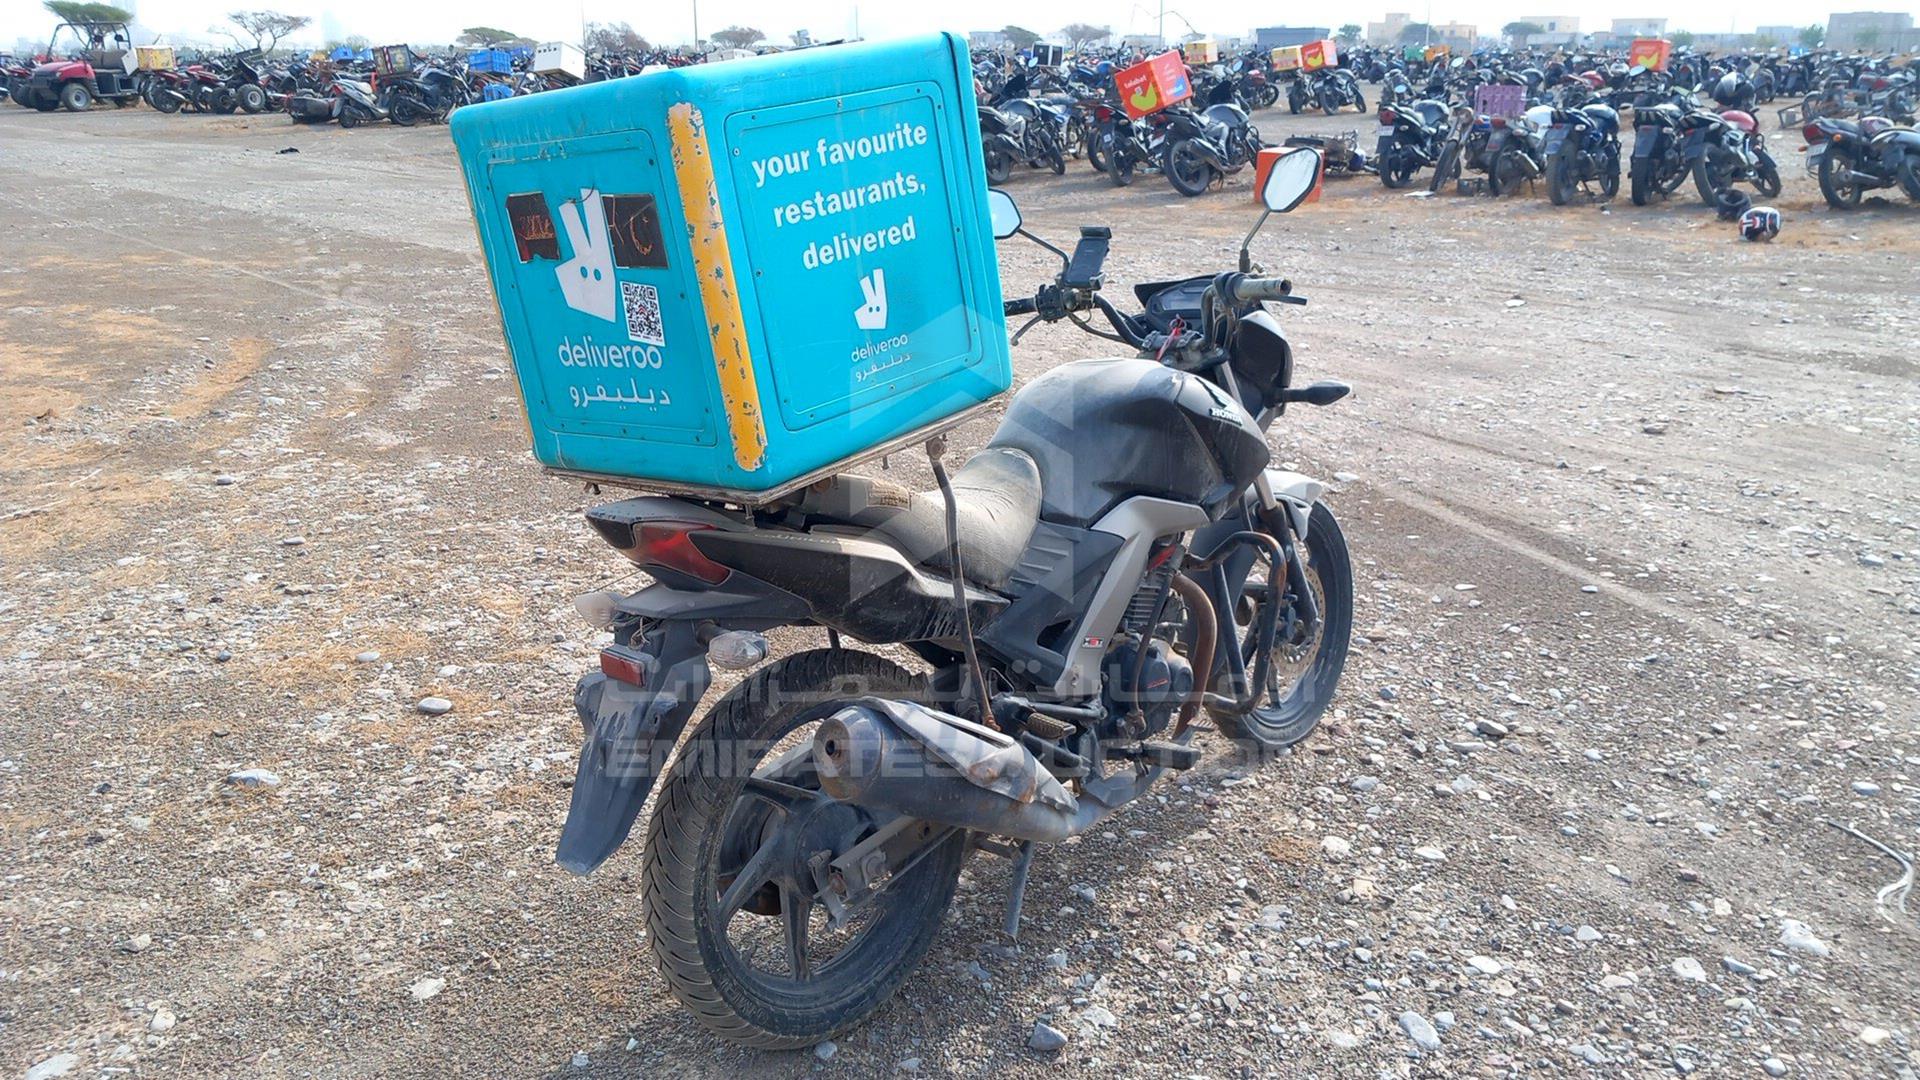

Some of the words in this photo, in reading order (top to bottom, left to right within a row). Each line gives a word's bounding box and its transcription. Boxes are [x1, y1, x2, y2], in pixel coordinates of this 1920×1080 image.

[751, 148, 811, 188] your
[816, 122, 929, 168] favourite
[773, 171, 927, 228] restaurants,
[802, 216, 917, 270] delivered
[558, 336, 664, 370] deliveroo
[851, 333, 909, 363] deliveroo
[856, 352, 912, 383] ديليفرو
[569, 377, 671, 412] ديليفرو
[1210, 408, 1243, 425] HONDA
